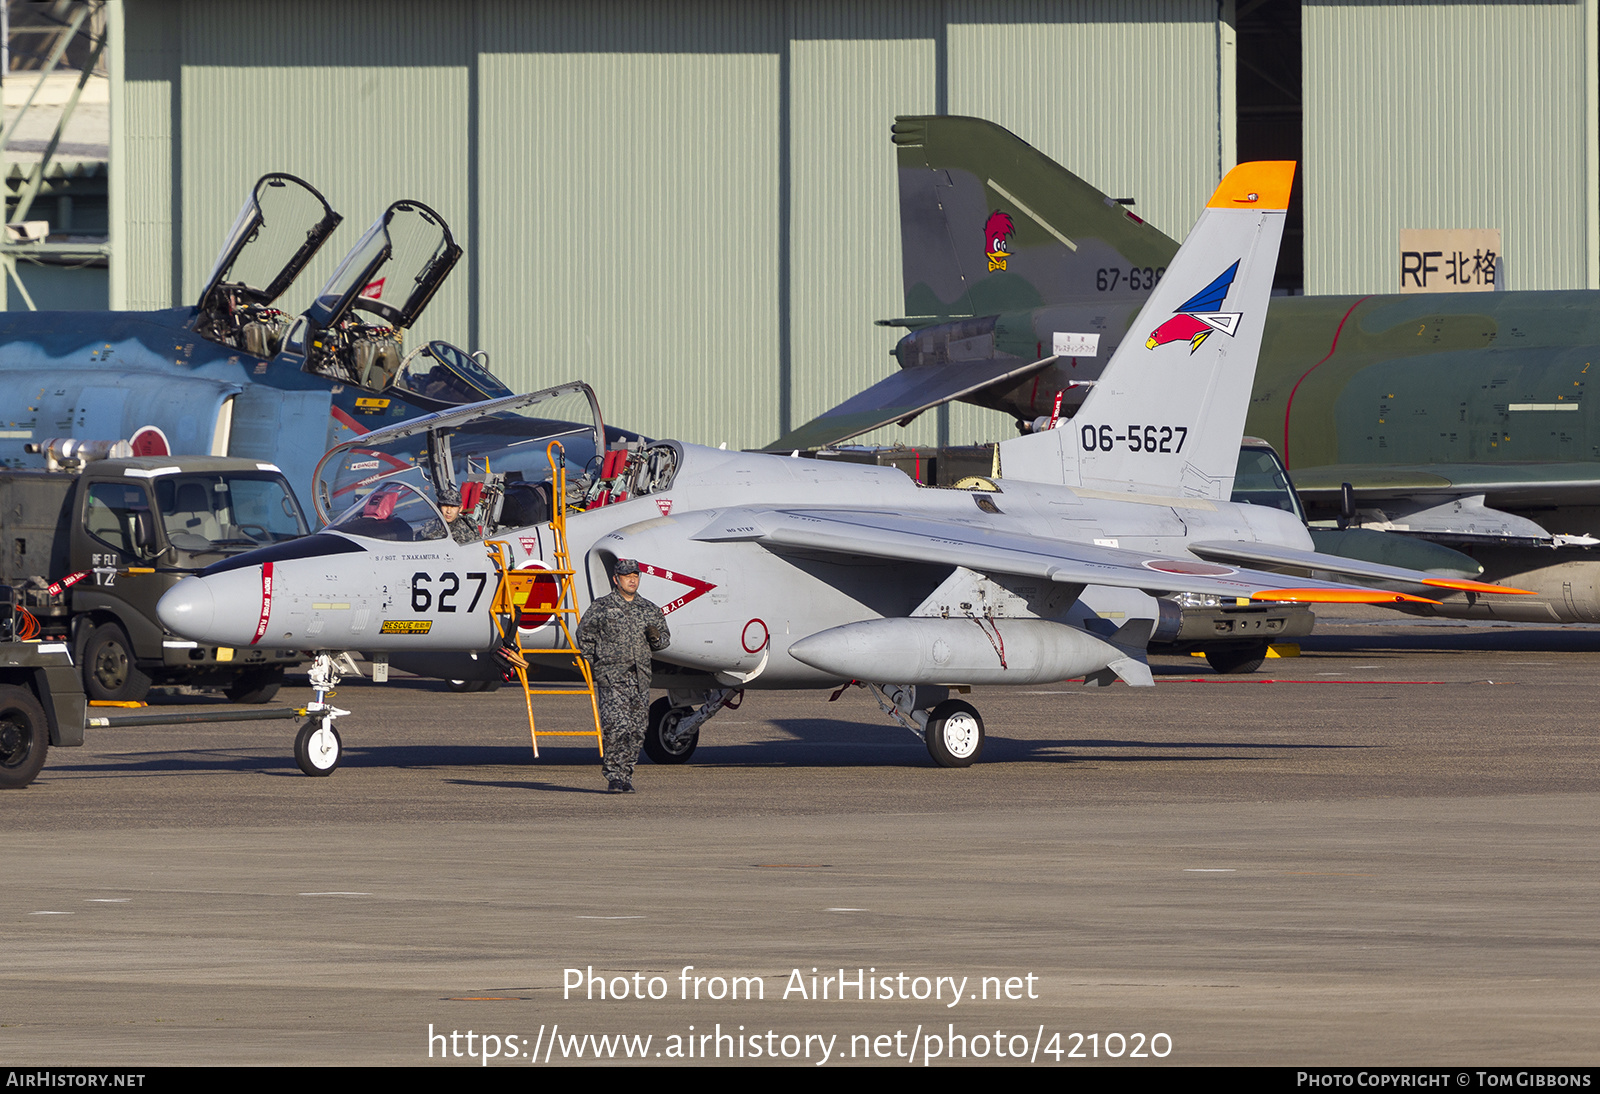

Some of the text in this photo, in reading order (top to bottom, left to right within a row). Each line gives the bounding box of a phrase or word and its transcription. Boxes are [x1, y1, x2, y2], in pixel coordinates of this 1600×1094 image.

[1417, 324, 1426, 335] 2
[1581, 362, 1590, 373] 2
[1081, 424, 1188, 453] 06-5627
[411, 571, 487, 613] 627
[384, 621, 414, 629] RESCUE
